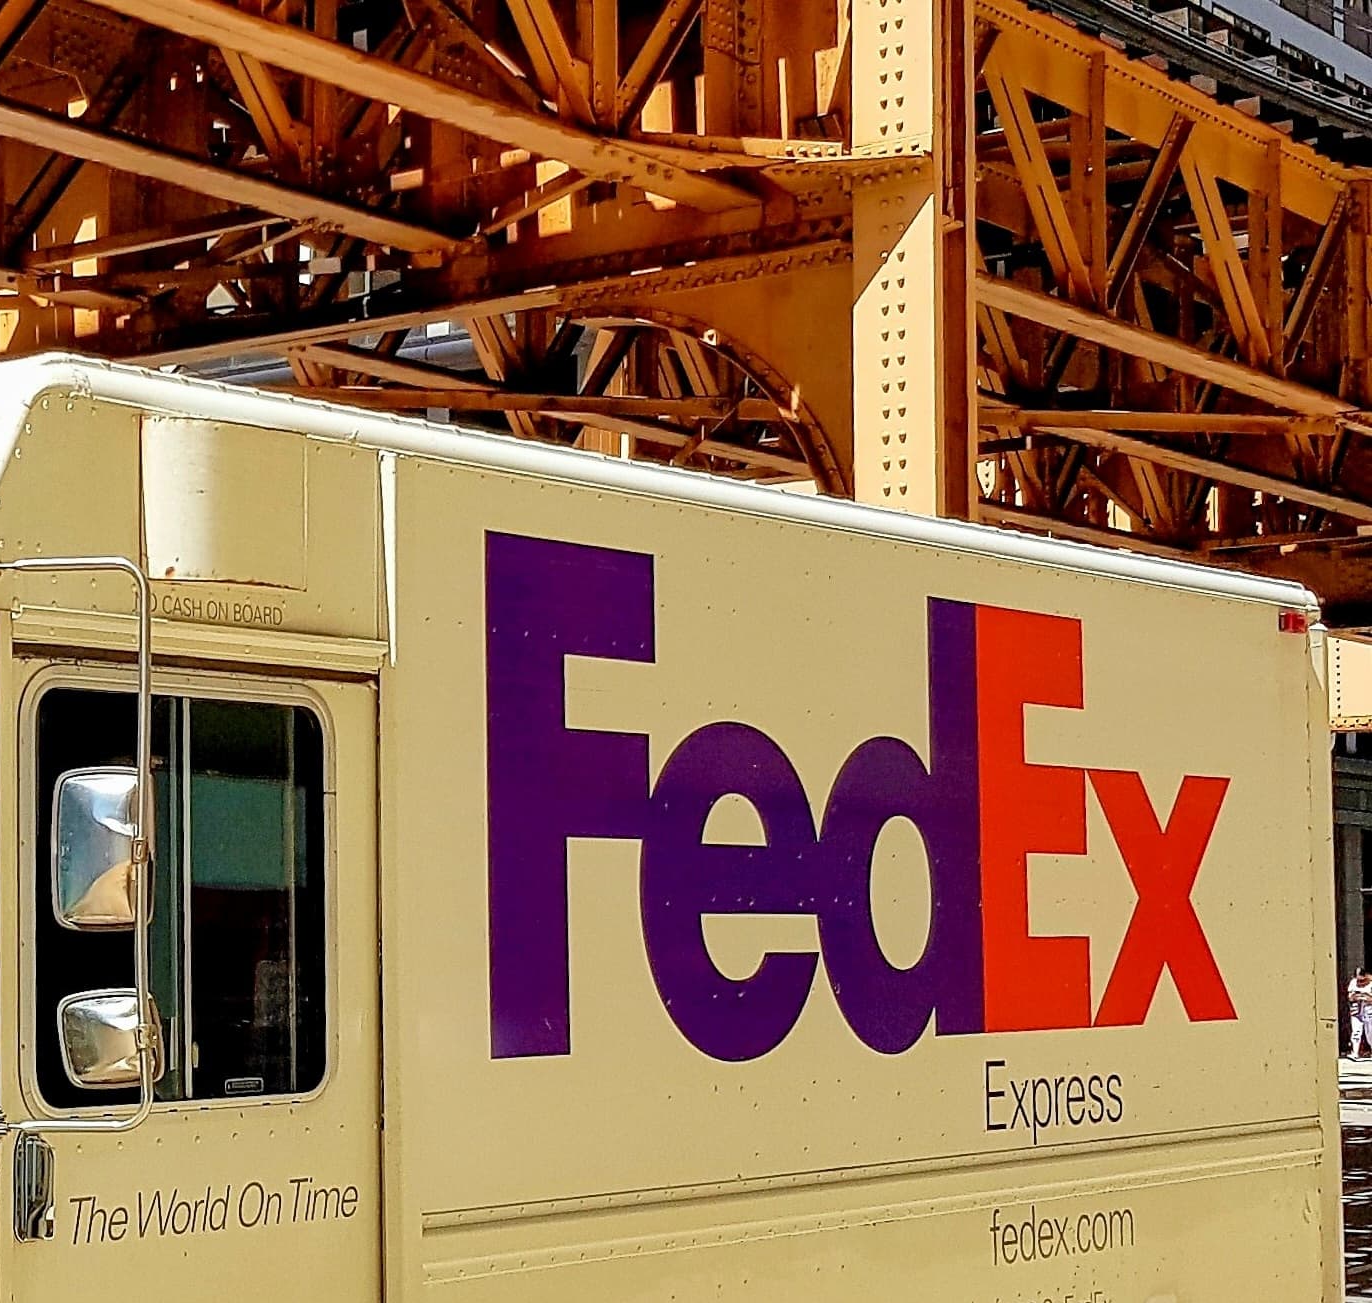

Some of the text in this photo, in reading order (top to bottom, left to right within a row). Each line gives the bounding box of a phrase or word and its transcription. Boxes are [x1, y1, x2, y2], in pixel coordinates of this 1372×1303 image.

[162, 595, 203, 617] CASH
[207, 600, 229, 620] ON
[233, 603, 283, 625] BOARD
[484, 529, 1239, 1062] FedEx
[985, 1060, 1124, 1145] Express
[69, 1177, 359, 1245] The World On Time
[989, 1204, 1134, 1266] fedex.com
